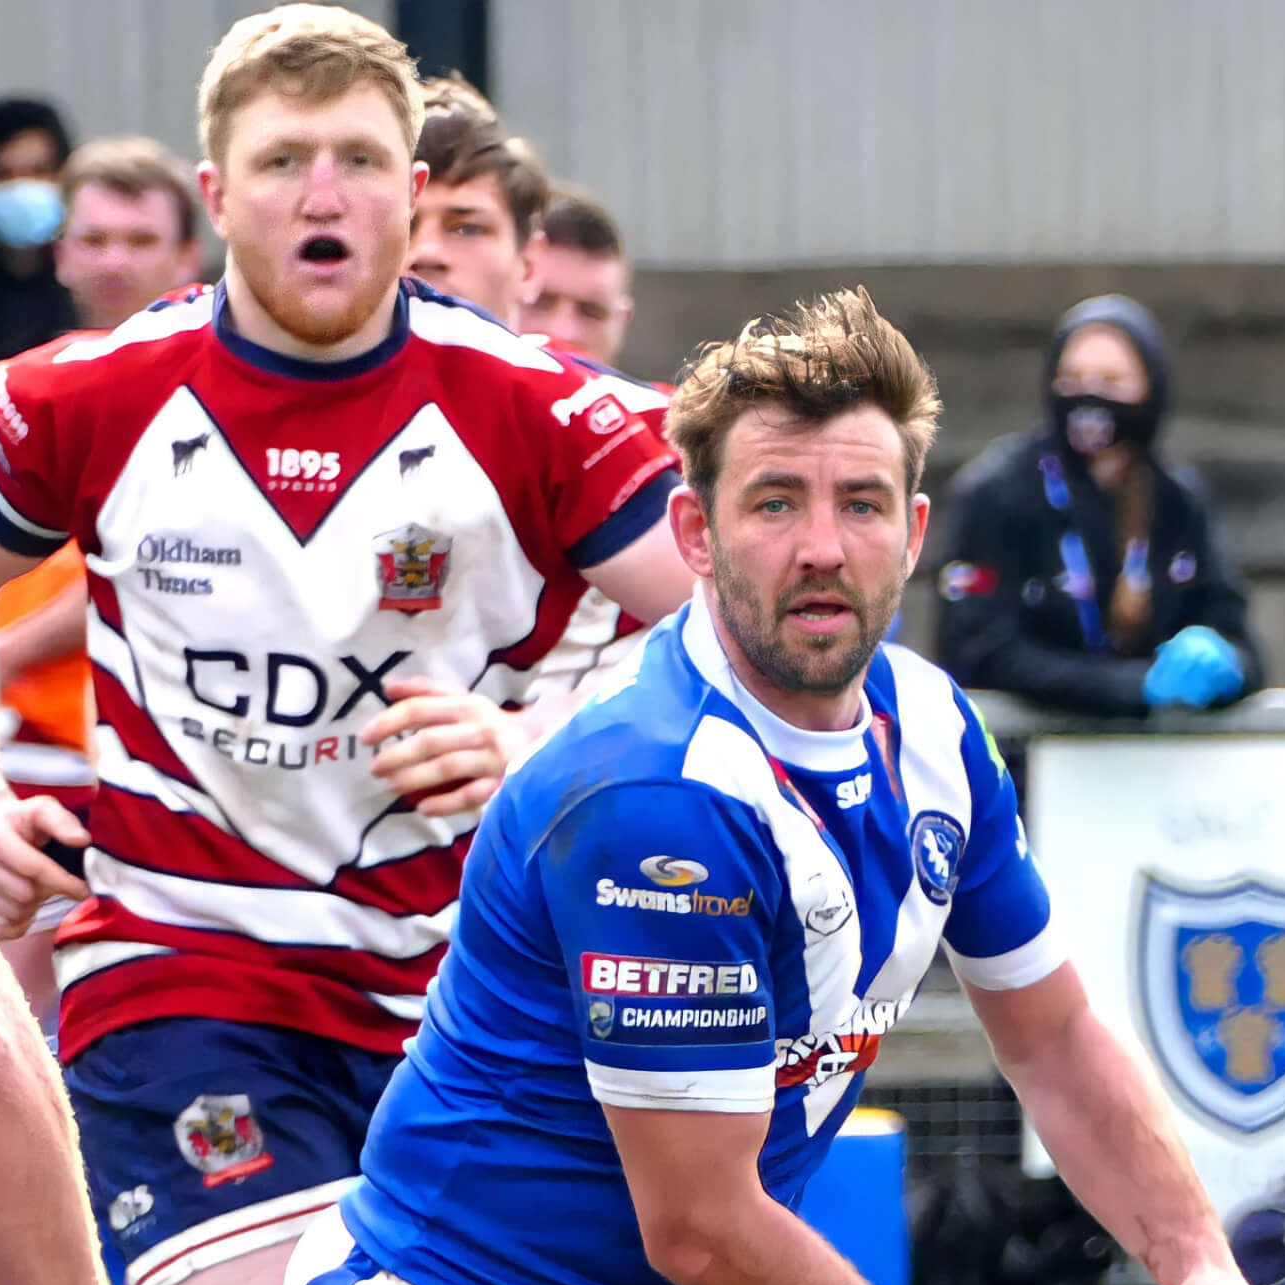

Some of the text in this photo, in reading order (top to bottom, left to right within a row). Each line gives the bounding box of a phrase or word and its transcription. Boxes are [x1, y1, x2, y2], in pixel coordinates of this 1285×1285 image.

[265, 447, 341, 481] 1895
[136, 533, 242, 566] Oldham
[136, 568, 214, 595] Times
[182, 647, 414, 728] CDX
[181, 716, 407, 770] SECURI
[590, 959, 758, 995] BETFRED
[622, 1005, 767, 1029] CHAMPIONSHIP
